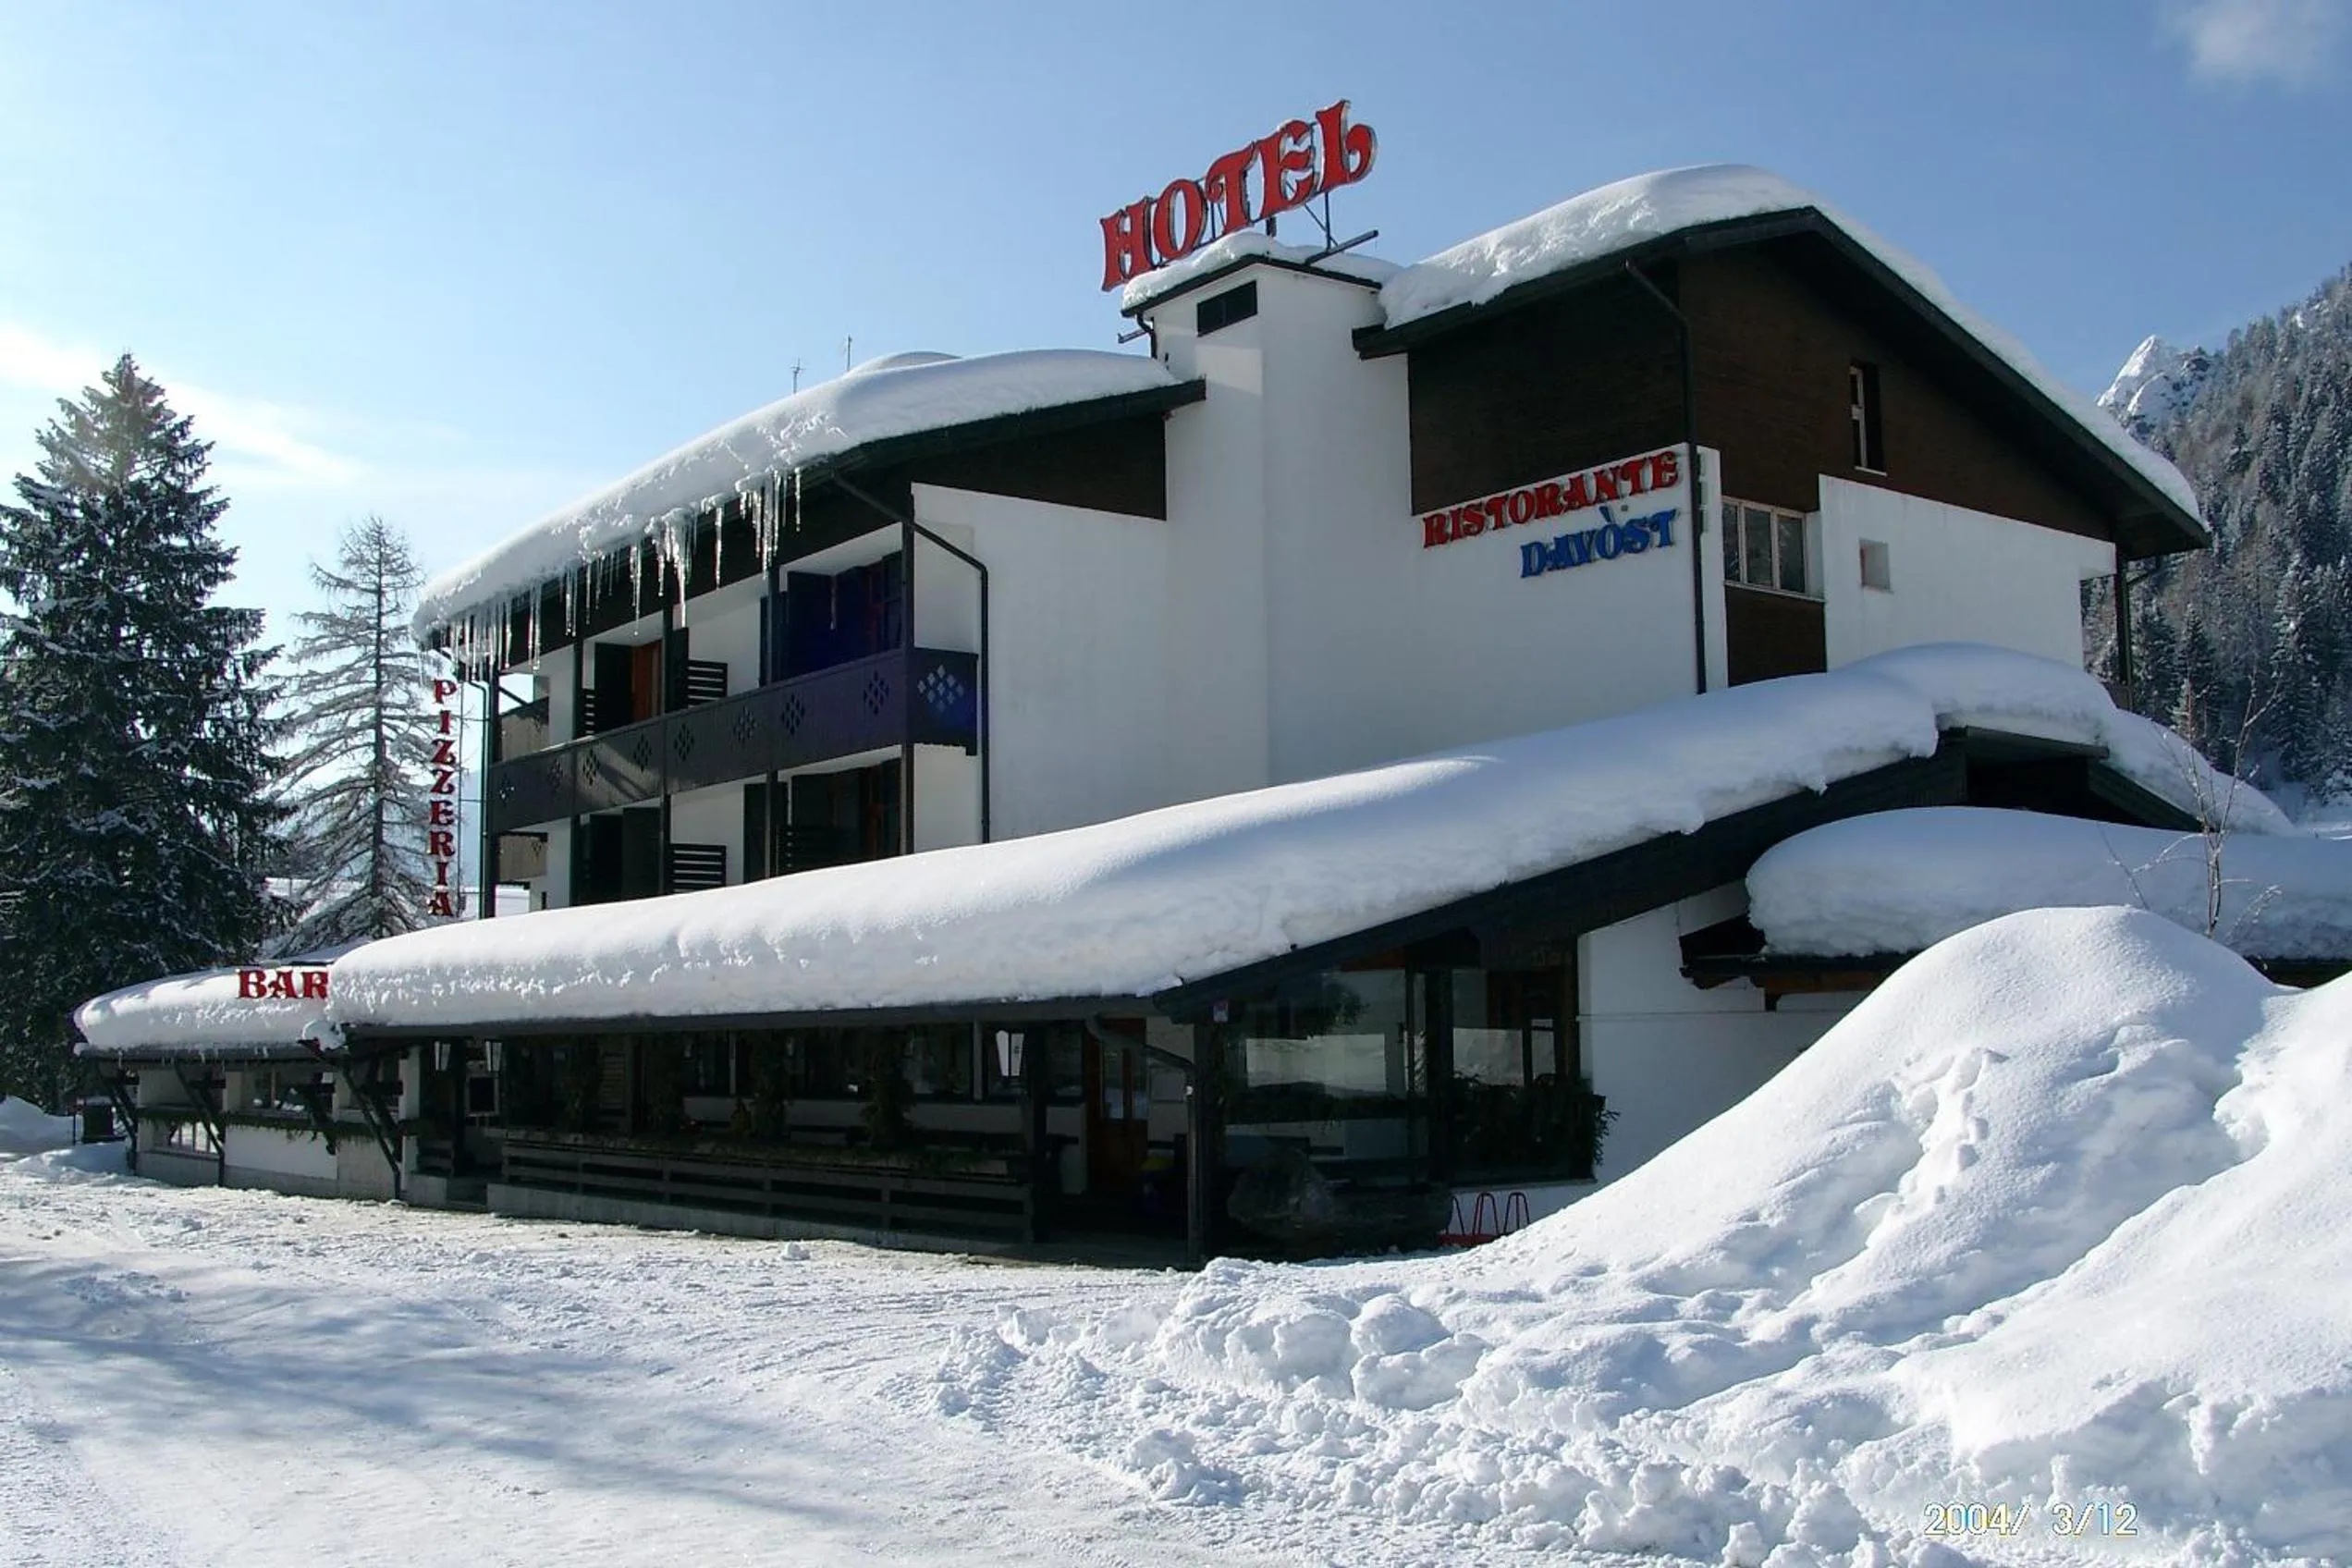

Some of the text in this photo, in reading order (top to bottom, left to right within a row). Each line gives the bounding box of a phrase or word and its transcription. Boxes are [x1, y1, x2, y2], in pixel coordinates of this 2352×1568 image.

[1100, 100, 1377, 291] HOTEL
[1423, 450, 1679, 548] RISTORANTE
[427, 678, 457, 917] PIZZERIA
[238, 968, 329, 999] BAR
